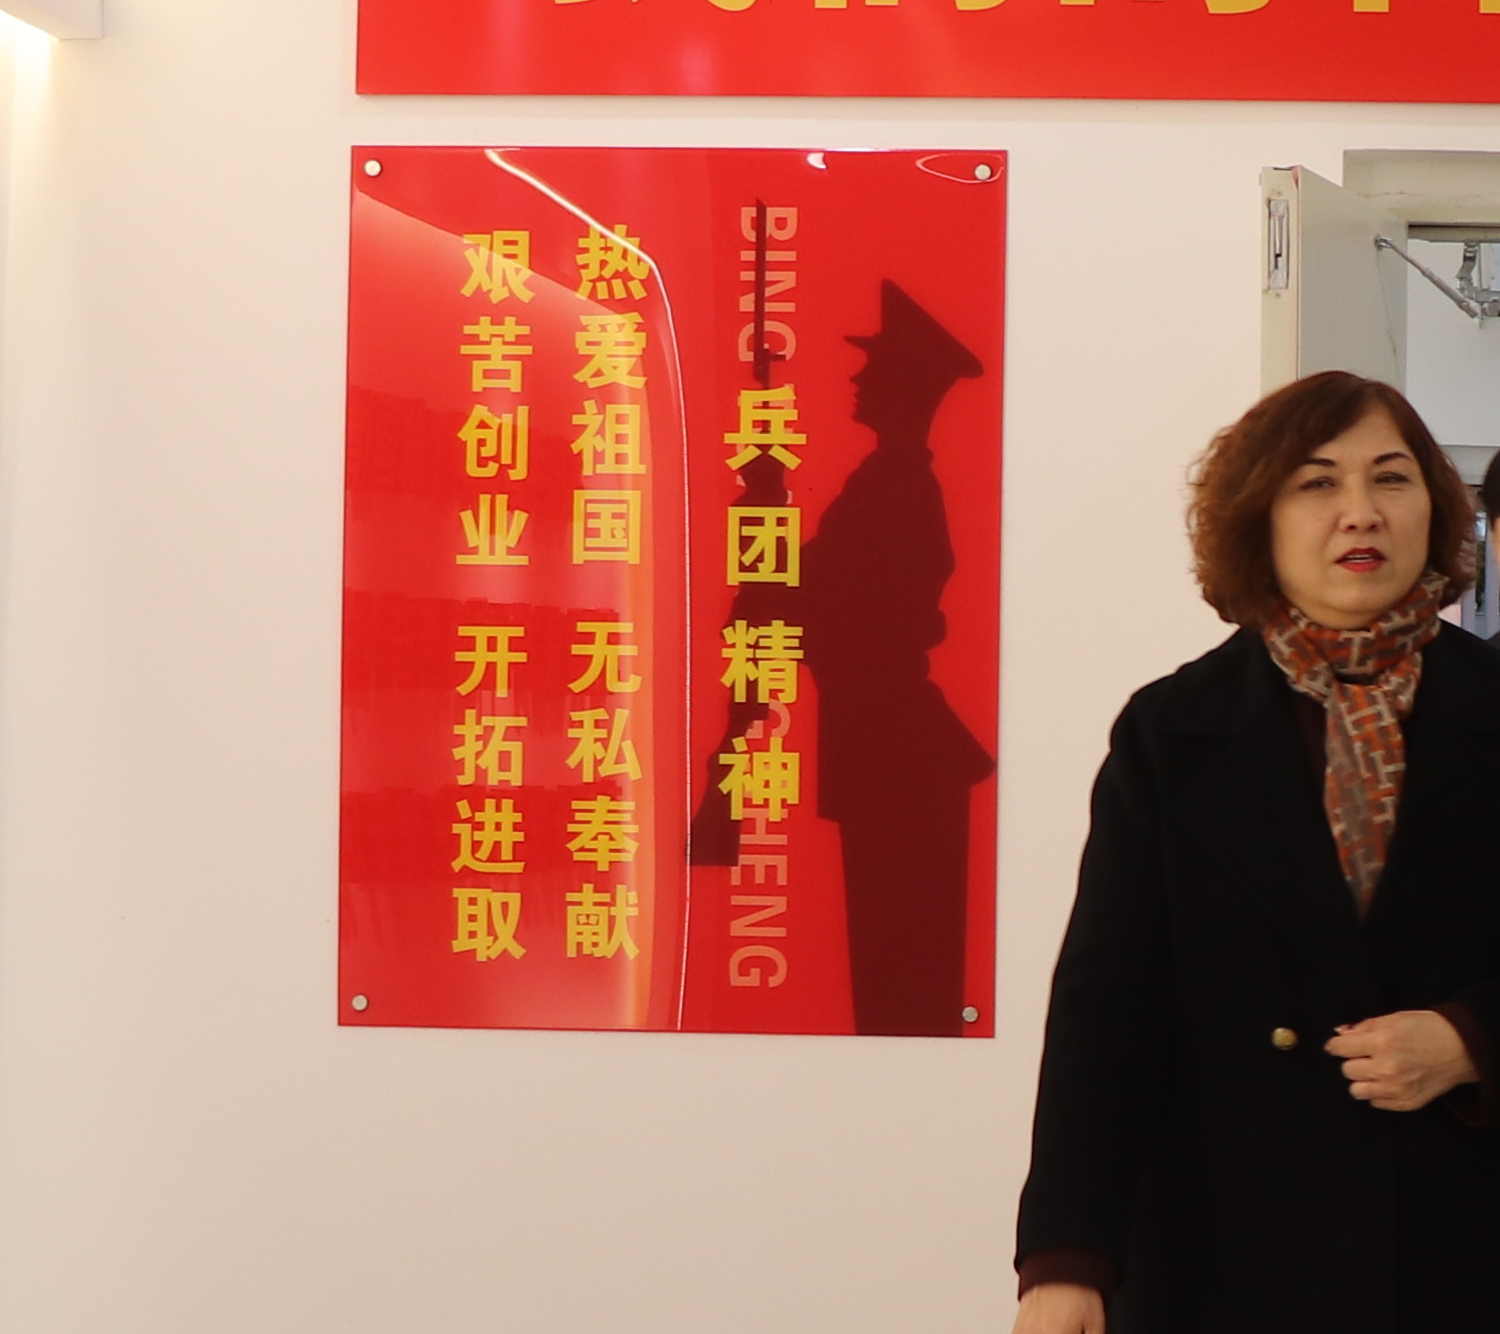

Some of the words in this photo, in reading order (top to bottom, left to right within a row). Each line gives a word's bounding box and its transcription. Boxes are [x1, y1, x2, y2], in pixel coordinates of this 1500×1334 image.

[456, 230, 535, 567] 艰苦创业
[570, 225, 650, 565] 热爱祖国
[738, 207, 798, 362] BING
[719, 387, 808, 822] 兵团精神
[451, 626, 529, 962] 开拓进取
[565, 622, 643, 960] 无私奉献
